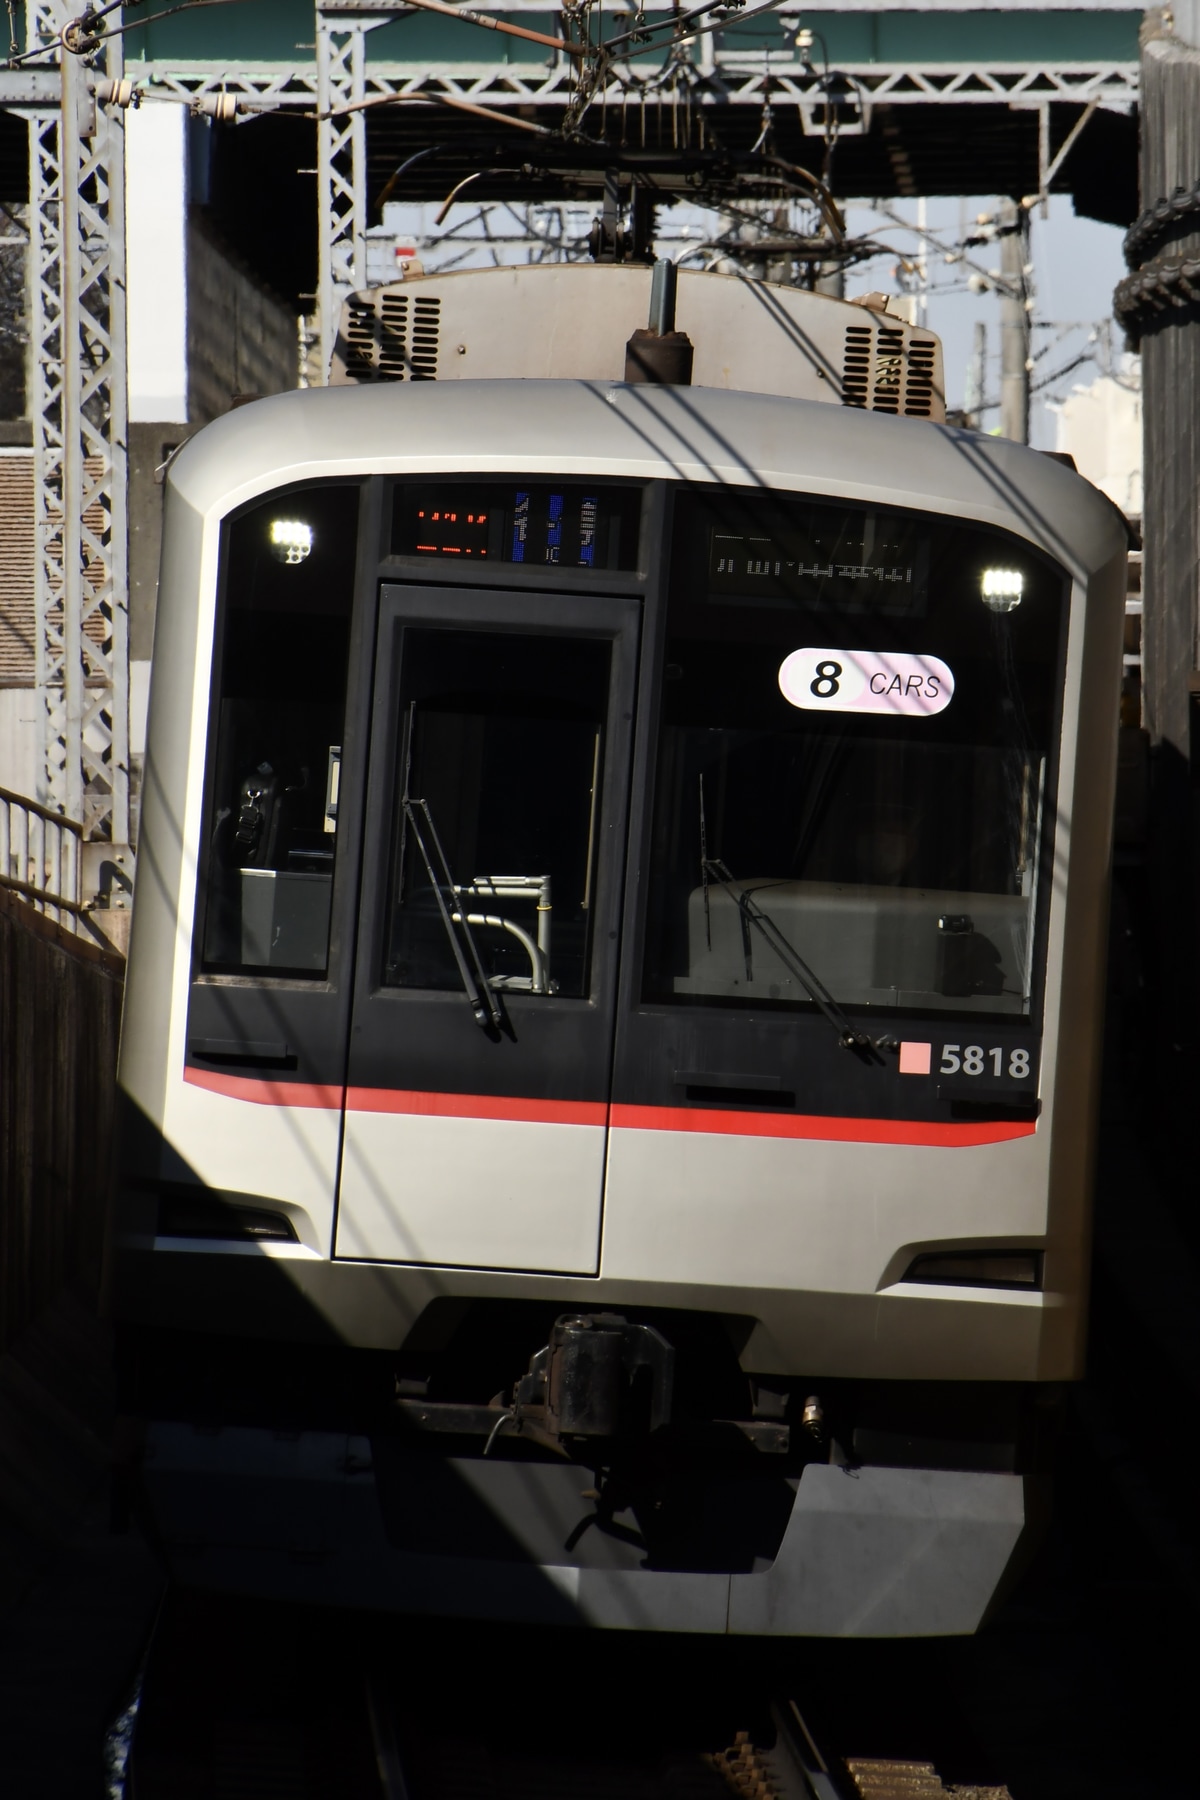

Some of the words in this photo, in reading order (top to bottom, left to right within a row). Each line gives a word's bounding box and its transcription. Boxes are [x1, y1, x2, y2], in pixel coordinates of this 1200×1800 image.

[809, 660, 843, 698] 8
[869, 672, 941, 698] CARS
[939, 1044, 1030, 1079] 5818
